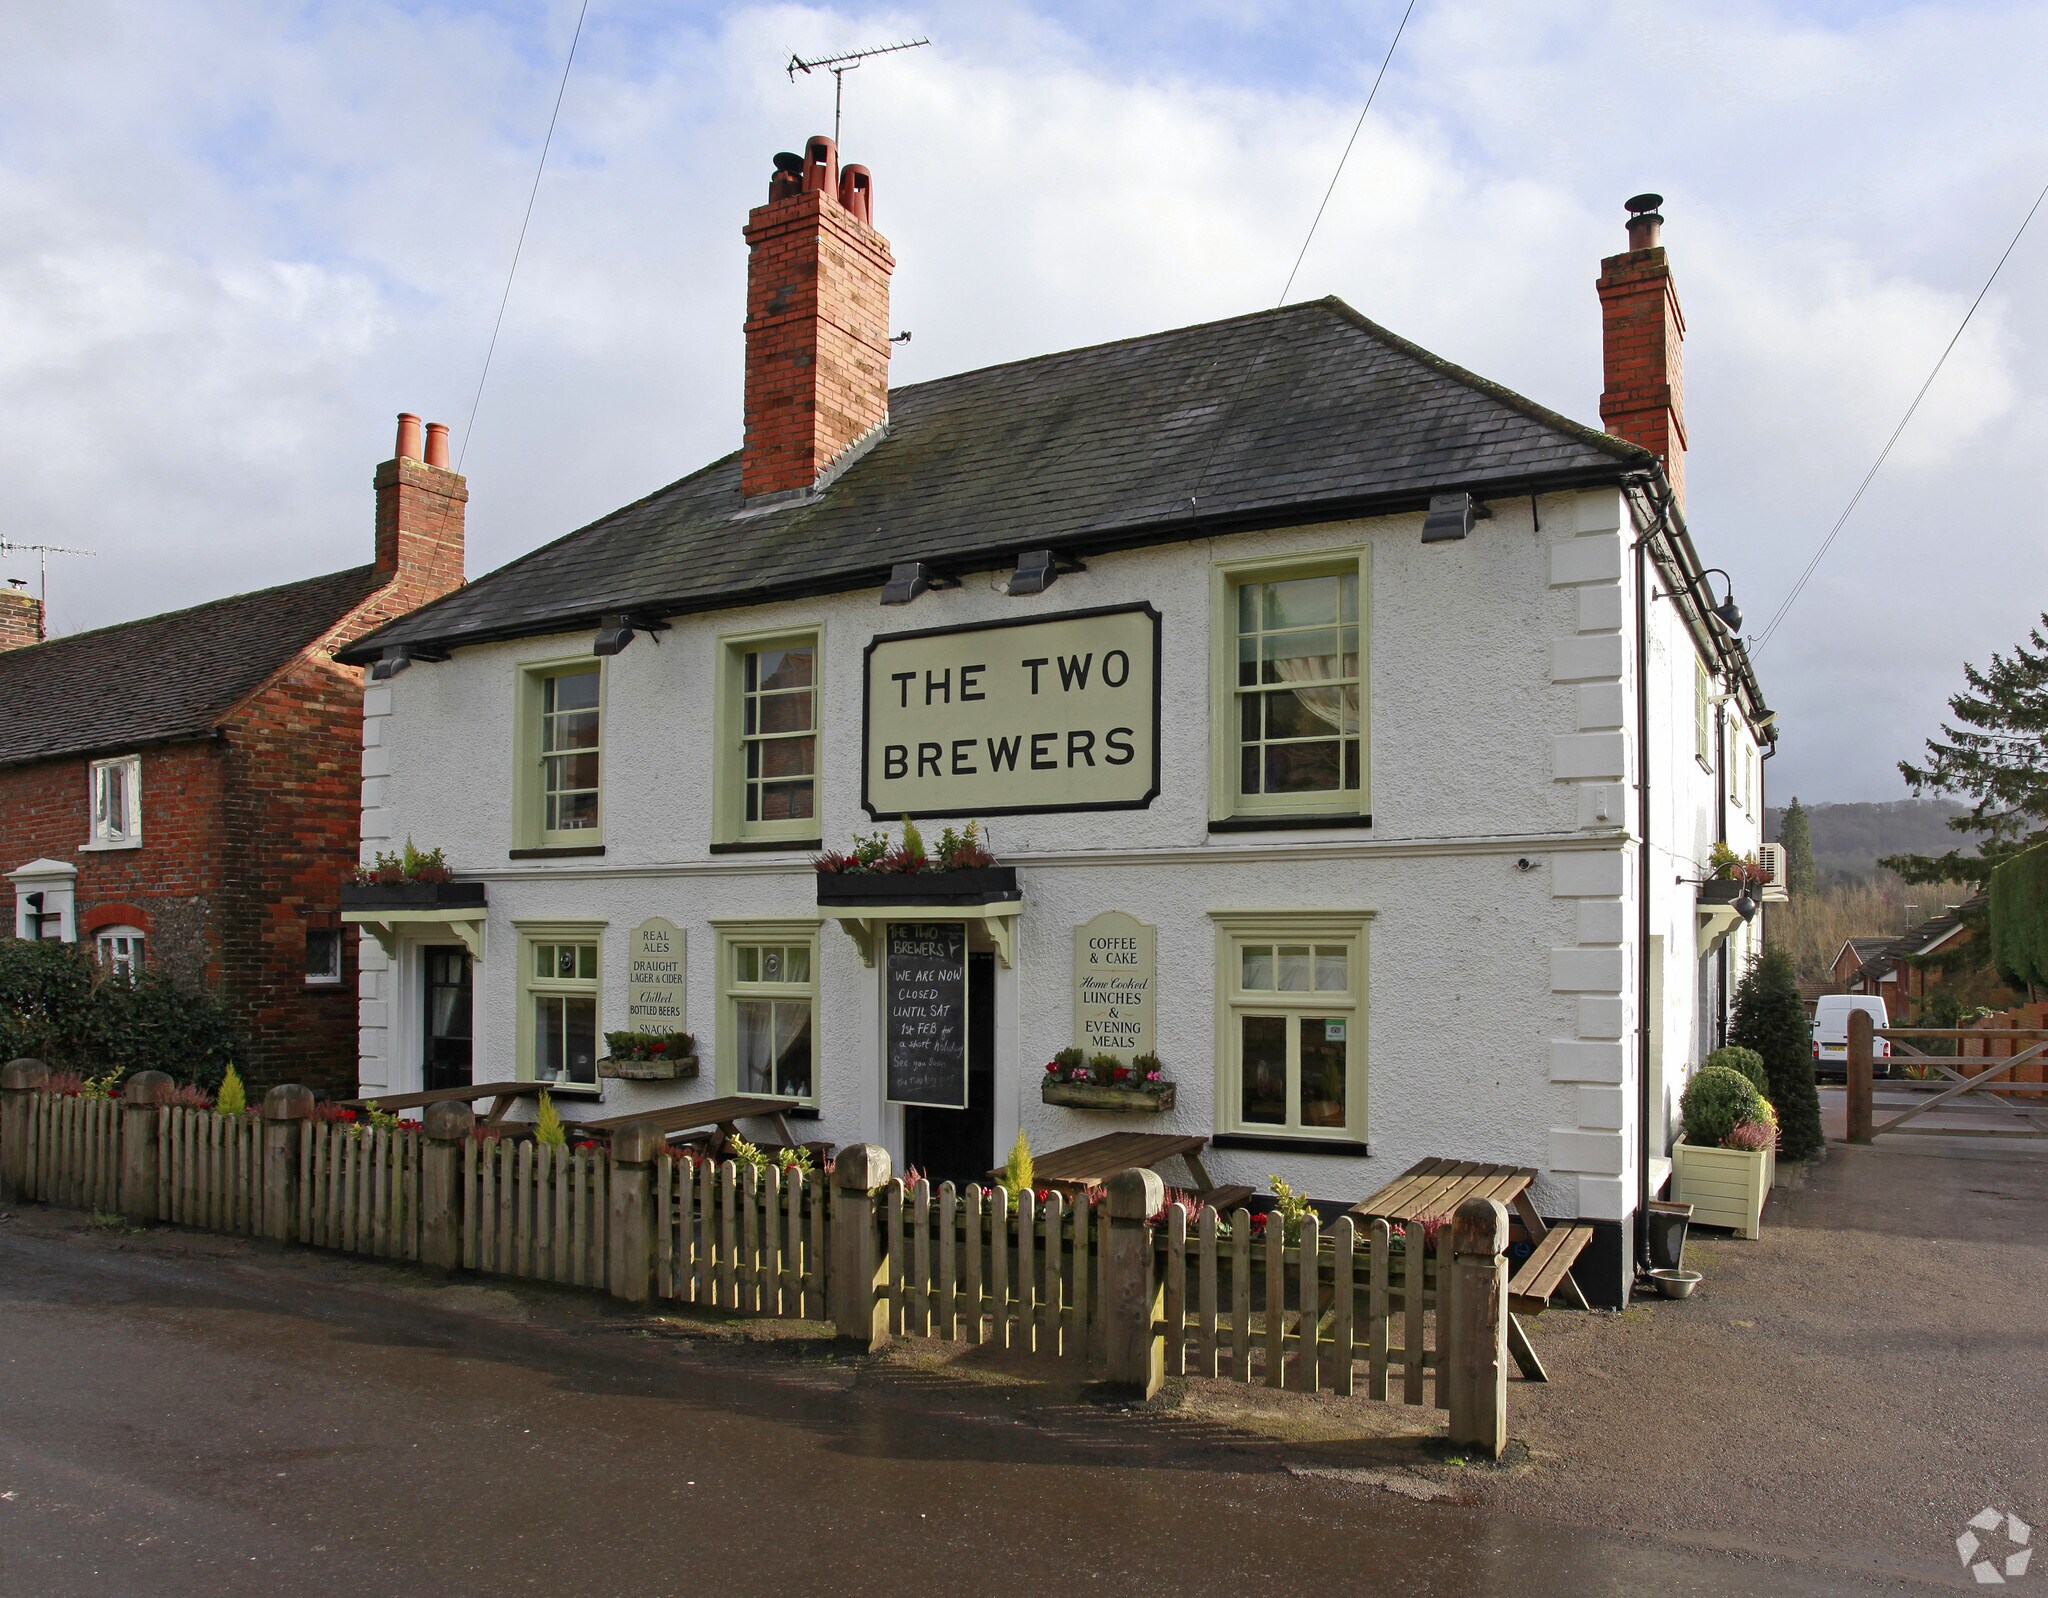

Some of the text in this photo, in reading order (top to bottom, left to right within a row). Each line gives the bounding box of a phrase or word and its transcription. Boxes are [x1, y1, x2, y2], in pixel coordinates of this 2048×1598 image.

[891, 649, 1130, 708] THE TWO
[884, 727, 1135, 780] BREWERS
[643, 931, 670, 940] REAL
[888, 924, 908, 939] THE
[914, 924, 938, 940] TWO
[643, 943, 669, 953] ALES
[893, 940, 945, 957] BREWERS
[1089, 938, 1137, 950] COFFEE
[1090, 953, 1138, 964] & CAKE
[633, 961, 678, 972] DRAUGHT
[630, 973, 654, 983] LAGER
[661, 974, 683, 984] CIDER
[896, 967, 962, 982] WE ARE NOW
[1079, 975, 1149, 990] Home Cooked
[640, 990, 673, 1004] Chilled
[898, 988, 939, 1000] CLOSED
[1083, 991, 1142, 1005] LUNCHES
[630, 1005, 680, 1017] BOTTLED BEERS
[893, 1004, 951, 1018] UNTIL SAT
[1108, 1007, 1119, 1019] &
[640, 1024, 674, 1035] SNACKS
[917, 1022, 937, 1035] FEB
[1085, 1020, 1141, 1034] EVENING
[1092, 1035, 1135, 1048] MEALS
